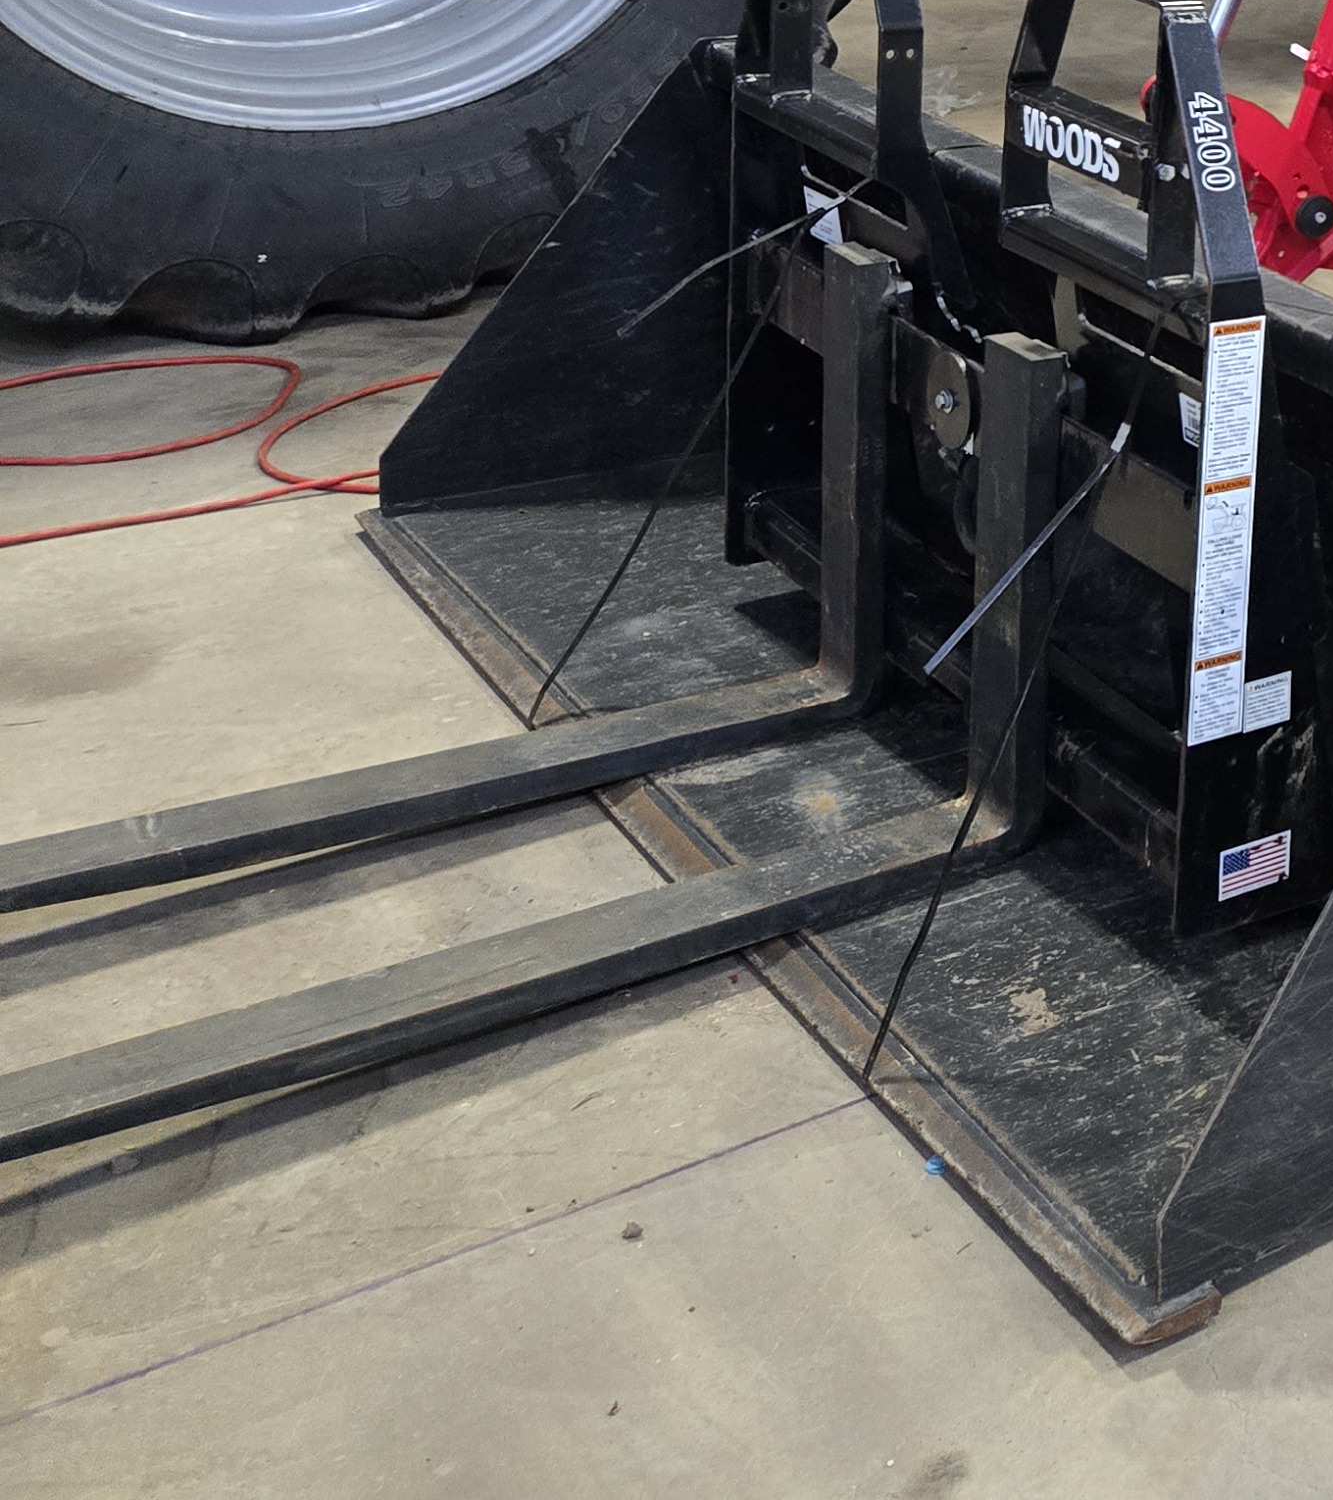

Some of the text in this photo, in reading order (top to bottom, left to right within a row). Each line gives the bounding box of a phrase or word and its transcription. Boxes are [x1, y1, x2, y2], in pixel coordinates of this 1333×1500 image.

[1021, 103, 1123, 184] WOODS
[1187, 90, 1237, 193] 4400
[1221, 321, 1261, 334] WARNING
[1213, 476, 1250, 493] WARNING
[1204, 651, 1241, 668] WARNING
[1254, 676, 1289, 691] WARNING
